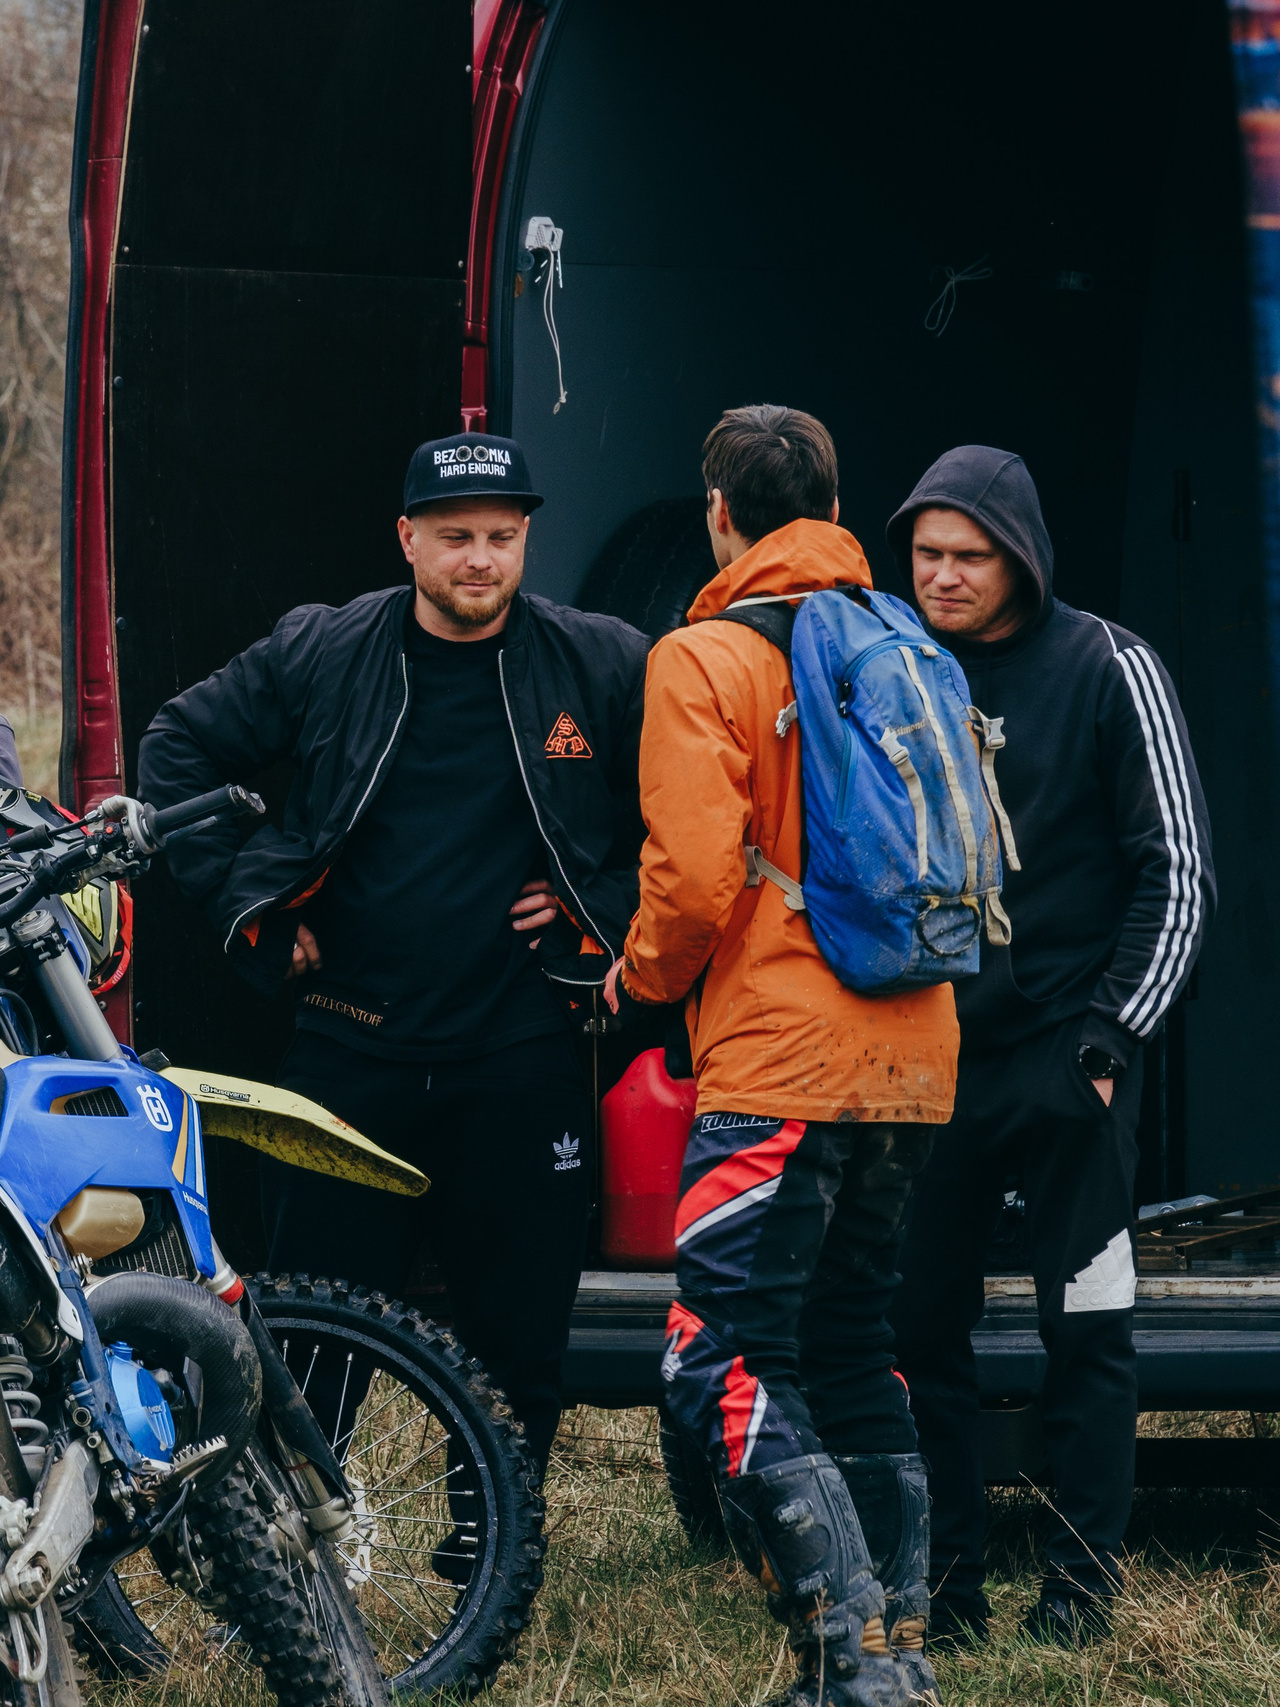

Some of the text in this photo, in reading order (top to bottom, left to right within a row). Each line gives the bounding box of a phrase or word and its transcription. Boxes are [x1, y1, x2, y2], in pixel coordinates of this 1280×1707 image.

[440, 462, 506, 478] HARD ENDURO
[554, 1158, 581, 1171] adidas
